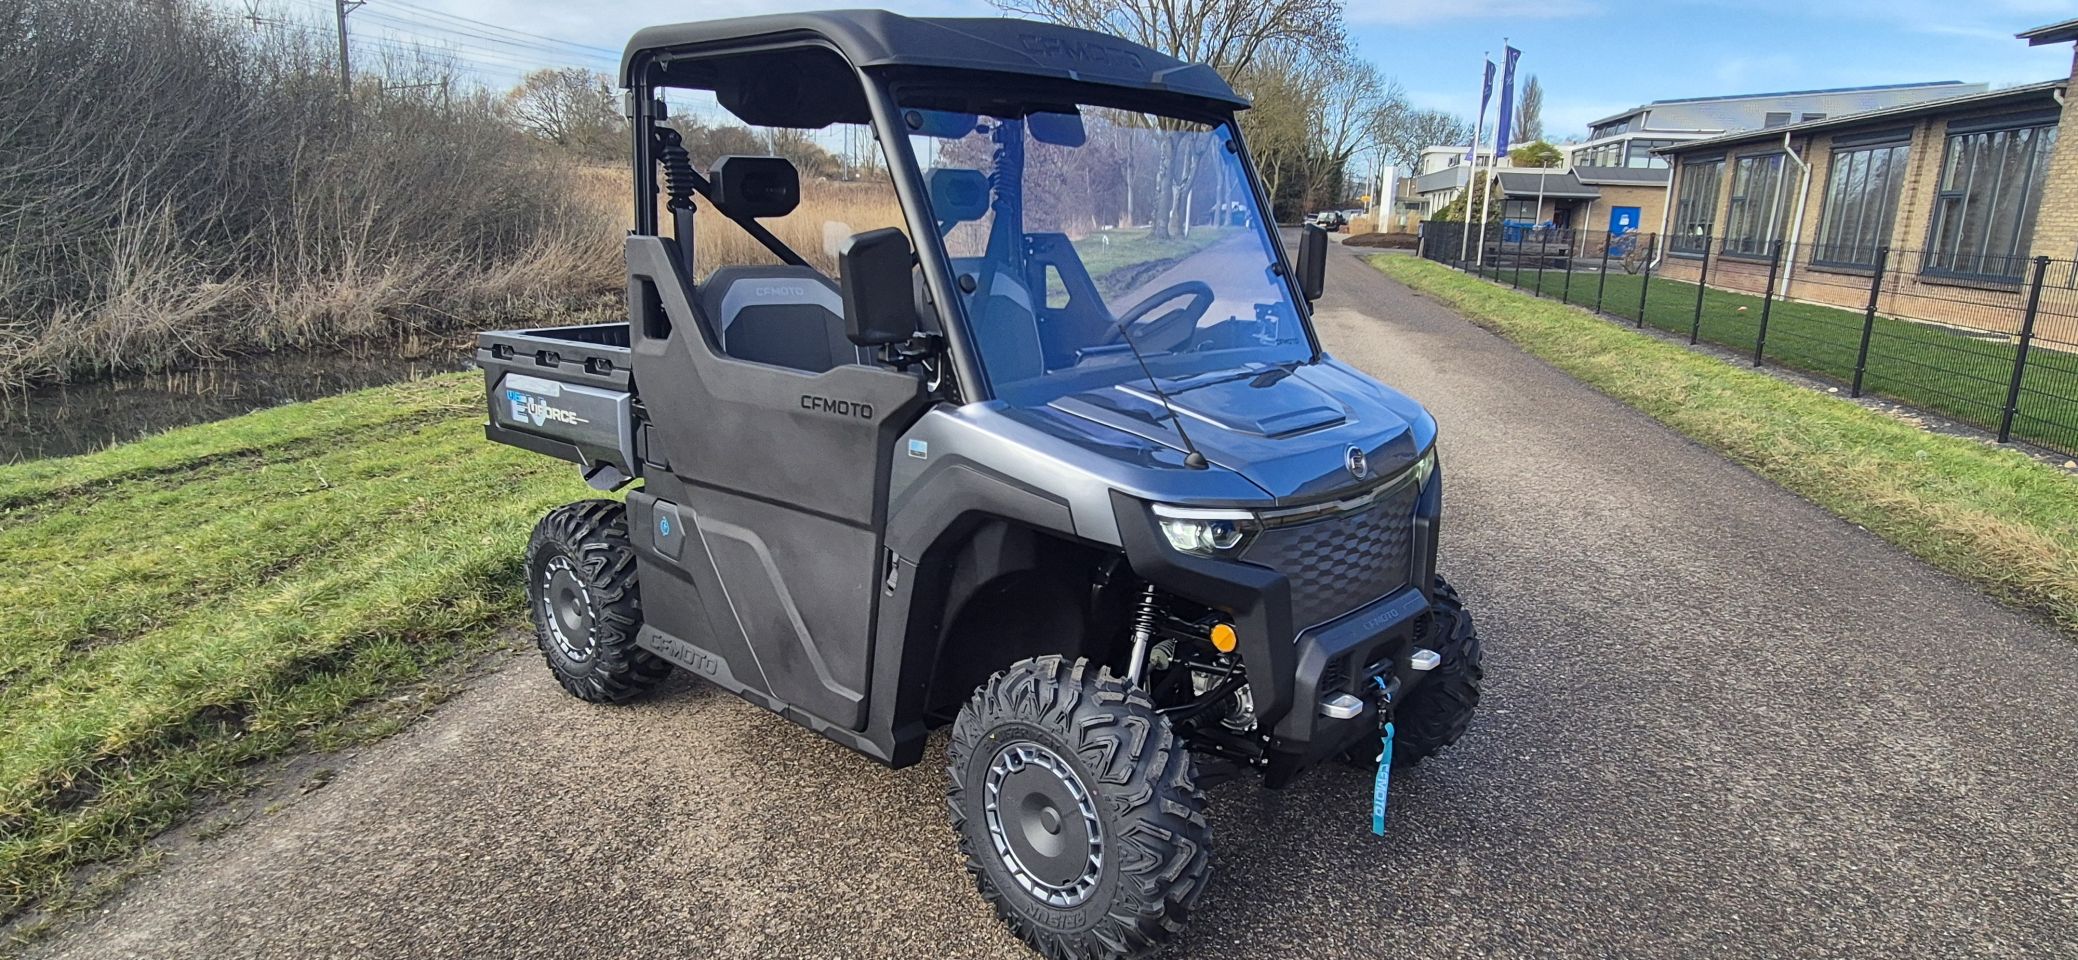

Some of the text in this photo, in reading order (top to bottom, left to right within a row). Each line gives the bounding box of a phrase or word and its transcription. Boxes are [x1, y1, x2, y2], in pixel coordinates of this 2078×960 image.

[755, 286, 804, 297] CFMOTO
[527, 402, 578, 425] UFORCE
[800, 394, 873, 420] CFMOTO
[651, 633, 718, 676] CFMOTO
[1375, 763, 1390, 817] CFMOTO
